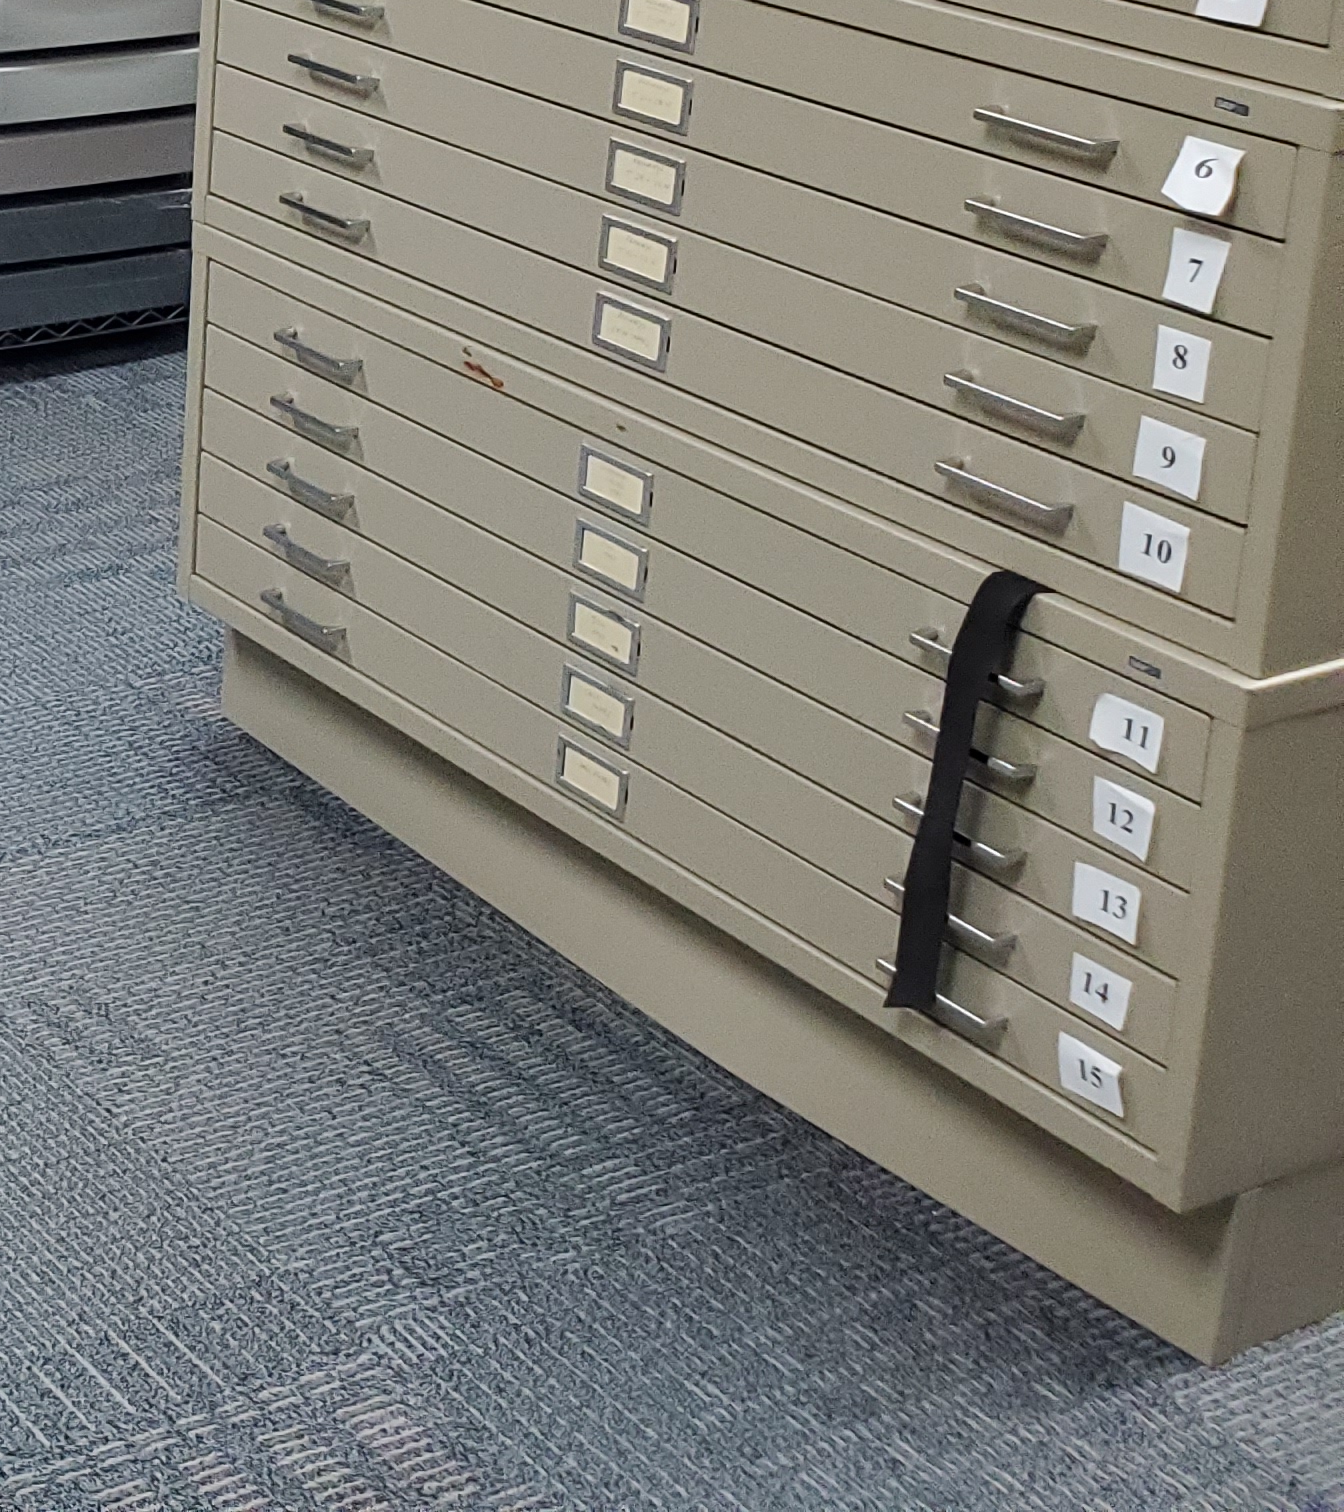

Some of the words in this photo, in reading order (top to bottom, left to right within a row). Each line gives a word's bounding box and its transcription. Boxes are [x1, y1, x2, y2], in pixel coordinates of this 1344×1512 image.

[1195, 159, 1218, 178] 6
[1190, 259, 1203, 282] 7
[1173, 345, 1187, 369] 8
[1162, 447, 1175, 468] 9
[1143, 534, 1172, 563] 10
[1124, 719, 1148, 749] 11
[1110, 803, 1133, 833] 12
[1101, 890, 1127, 919] 13
[1082, 972, 1110, 1003] 14
[1078, 1059, 1103, 1088] 15
